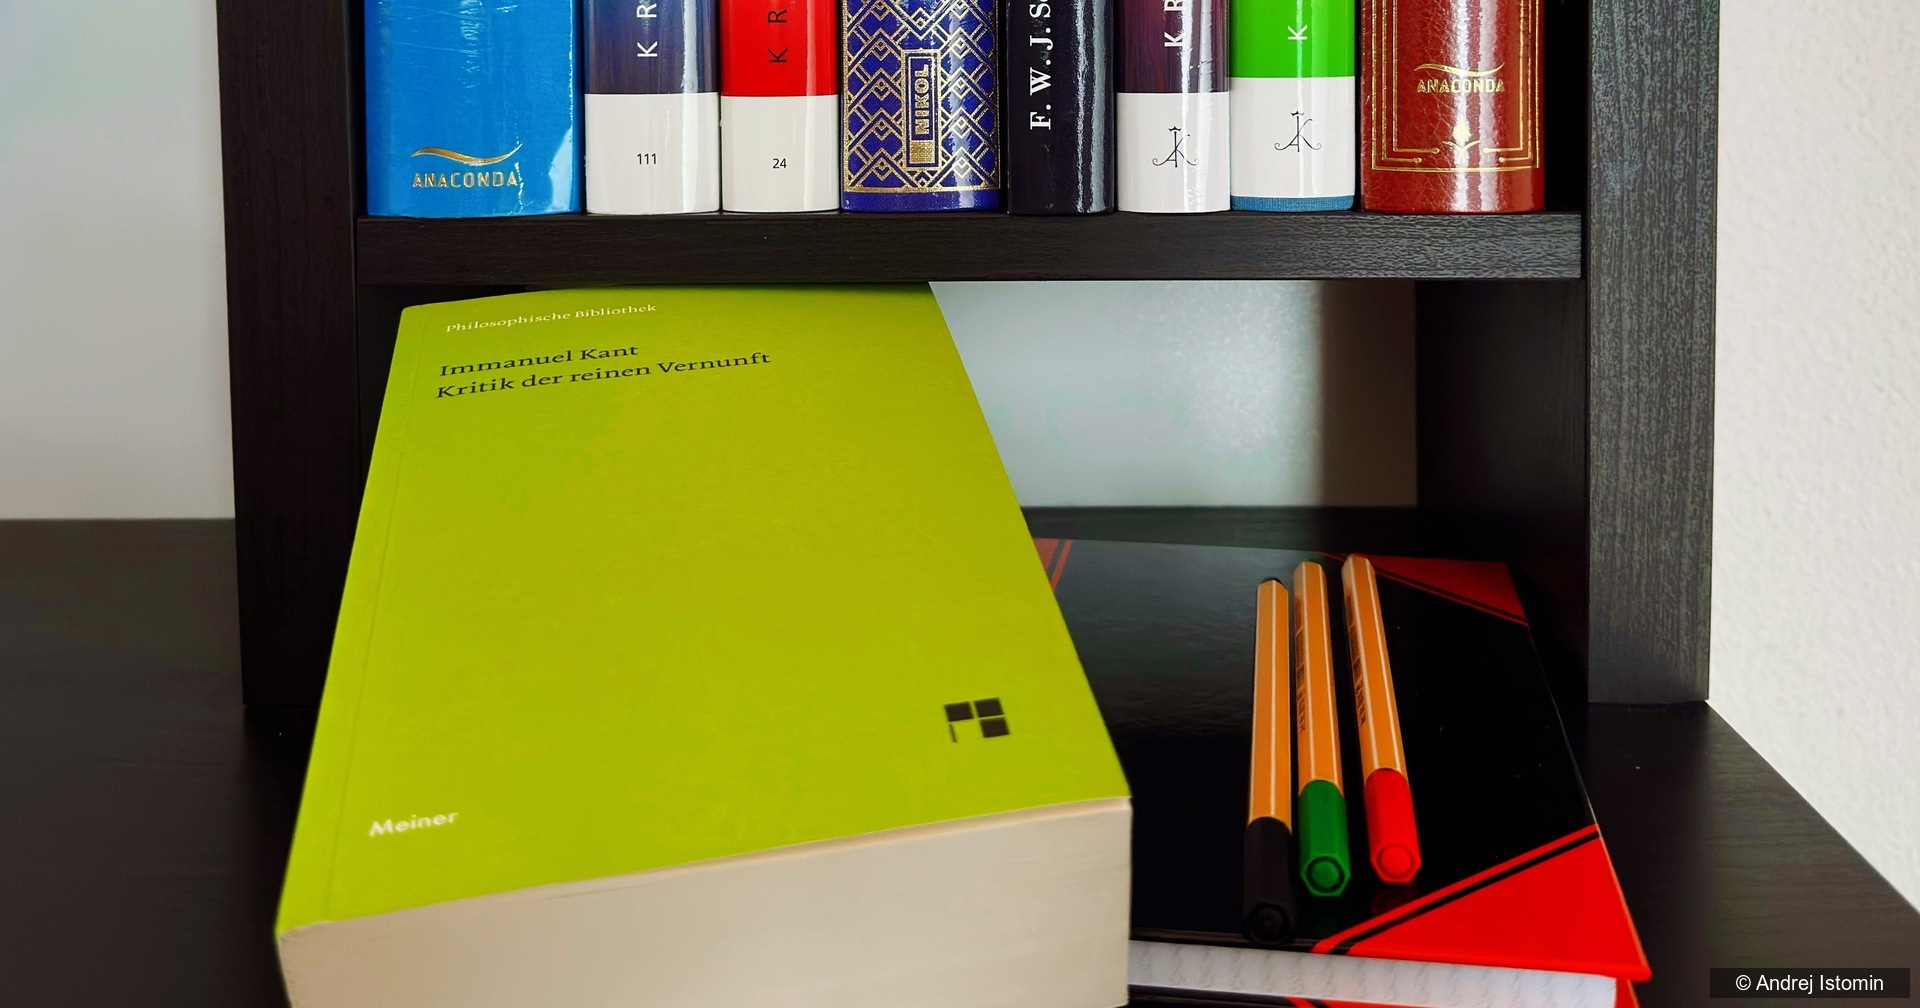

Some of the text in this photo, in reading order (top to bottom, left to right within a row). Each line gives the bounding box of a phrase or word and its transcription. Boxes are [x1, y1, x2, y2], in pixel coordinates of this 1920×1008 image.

[1417, 79, 1505, 93] ANACONDA
[914, 63, 930, 135] NIKOL
[636, 152, 658, 166] 111
[772, 157, 787, 170] 24
[413, 172, 518, 188] ANACONDA
[446, 304, 657, 332] Philosophische Bibliothek
[439, 345, 639, 376] Immanuel Kant
[435, 352, 771, 398] Kritik der reinen Vernunft
[369, 812, 458, 837] Meiner
